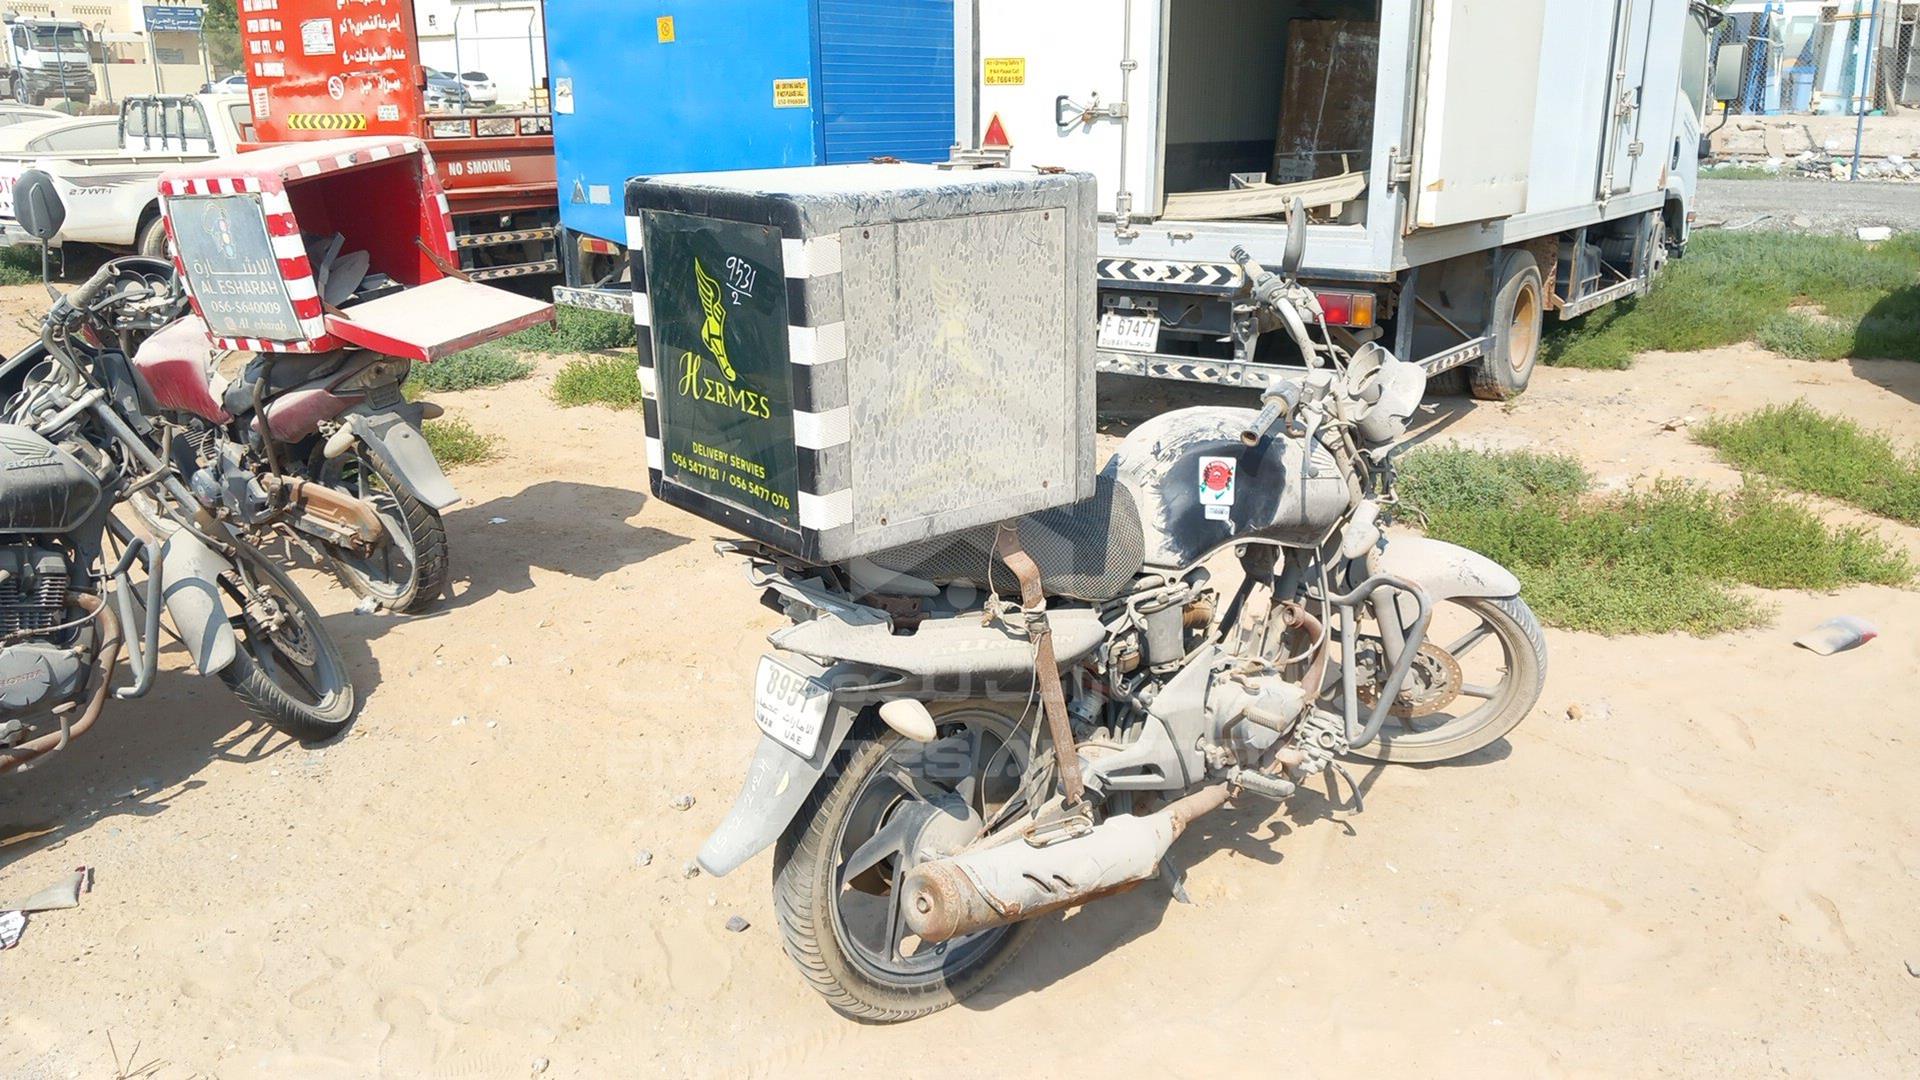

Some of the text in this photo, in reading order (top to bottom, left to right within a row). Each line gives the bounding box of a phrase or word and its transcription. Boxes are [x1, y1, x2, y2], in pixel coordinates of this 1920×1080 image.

[449, 159, 511, 176] NO SMOKING
[725, 256, 757, 293] 9531
[201, 280, 280, 296] AL ESHARAH
[731, 291, 742, 306] 2
[210, 300, 281, 315] 056-5640009
[1117, 318, 1157, 339] 67477
[692, 441, 767, 480] DELIVERY SERVIES
[671, 452, 687, 469] 056
[688, 461, 706, 478] 5477
[708, 467, 720, 481] 121
[729, 473, 747, 491] 056
[748, 481, 770, 502] 5477
[771, 492, 790, 511] 076
[784, 729, 802, 745] UAE
